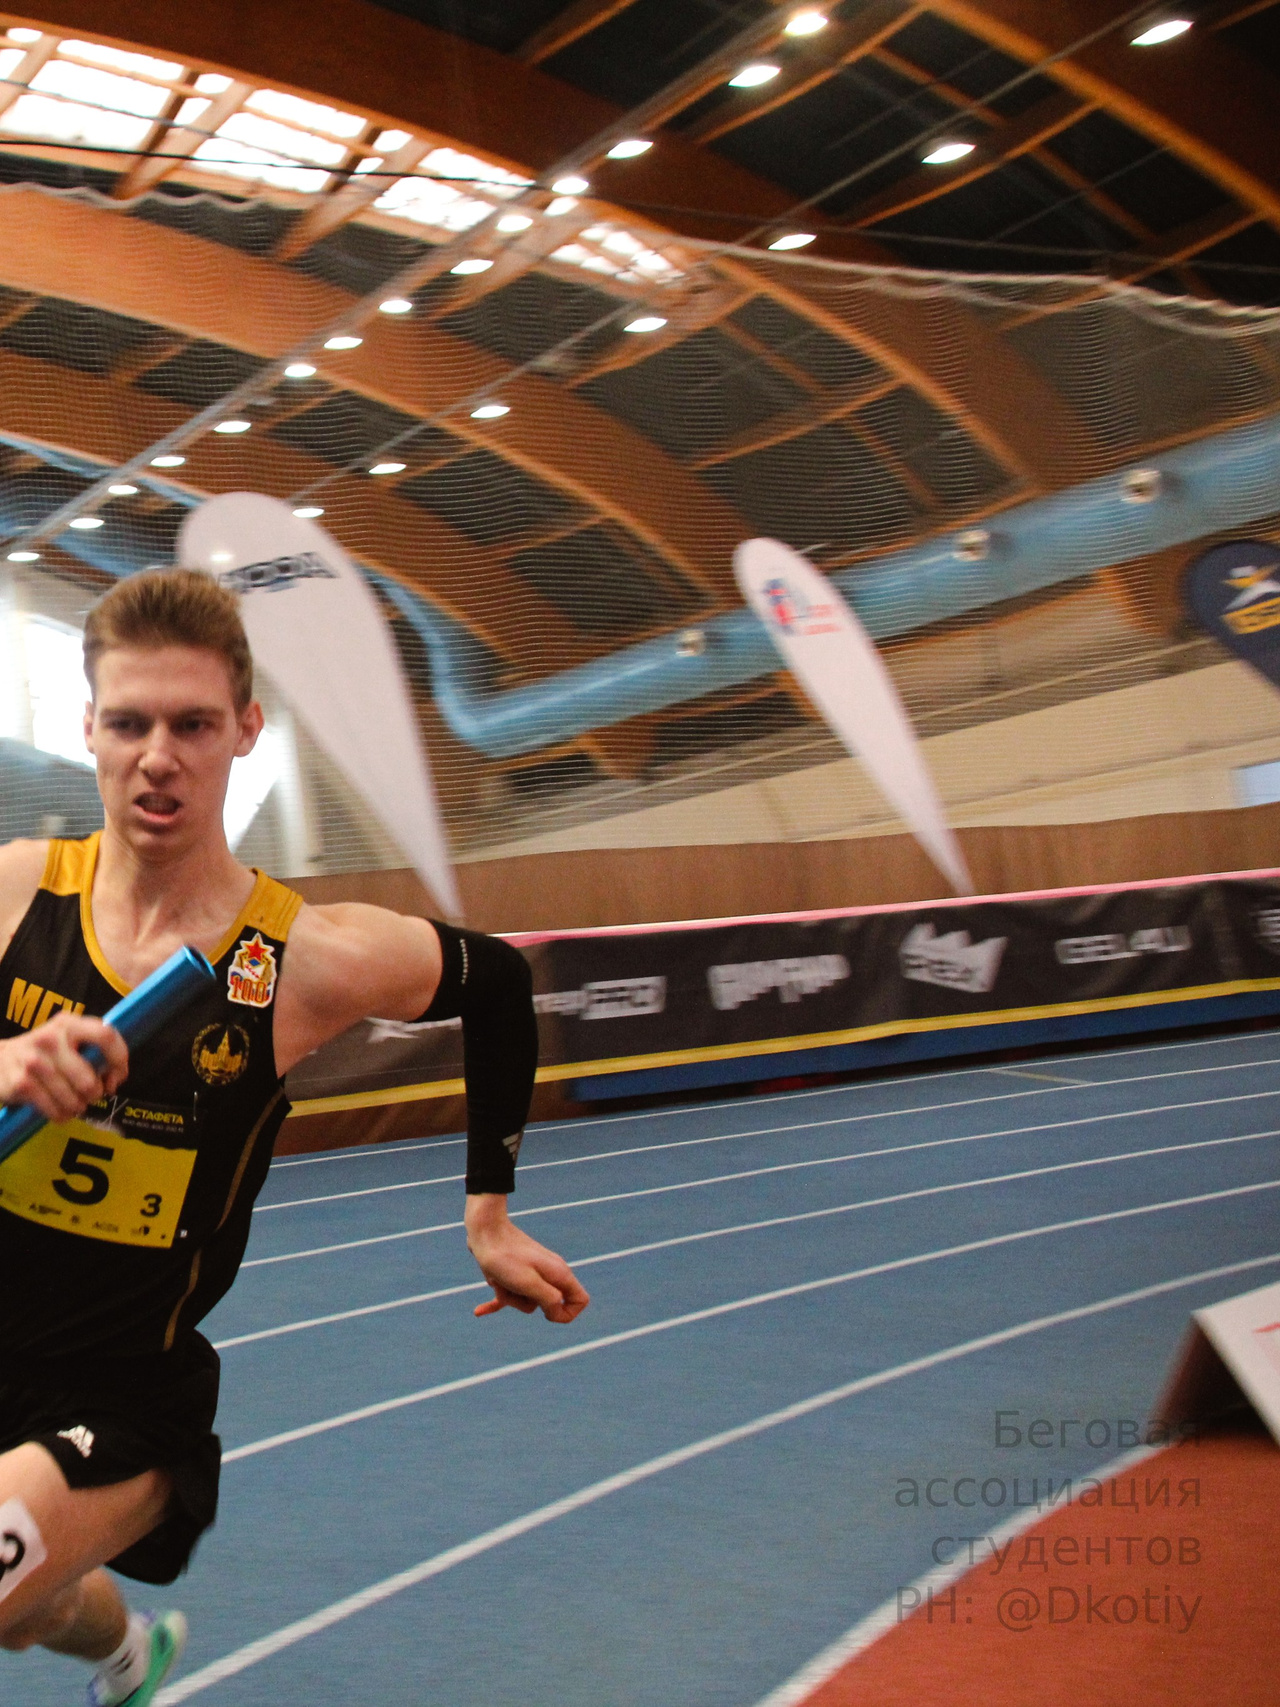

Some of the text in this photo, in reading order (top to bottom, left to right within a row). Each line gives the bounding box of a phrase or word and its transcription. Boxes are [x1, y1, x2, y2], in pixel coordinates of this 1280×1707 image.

[124, 1105, 184, 1125] ЭСТАФЕТА
[52, 1137, 114, 1206] 5
[140, 1193, 163, 1217] 3
